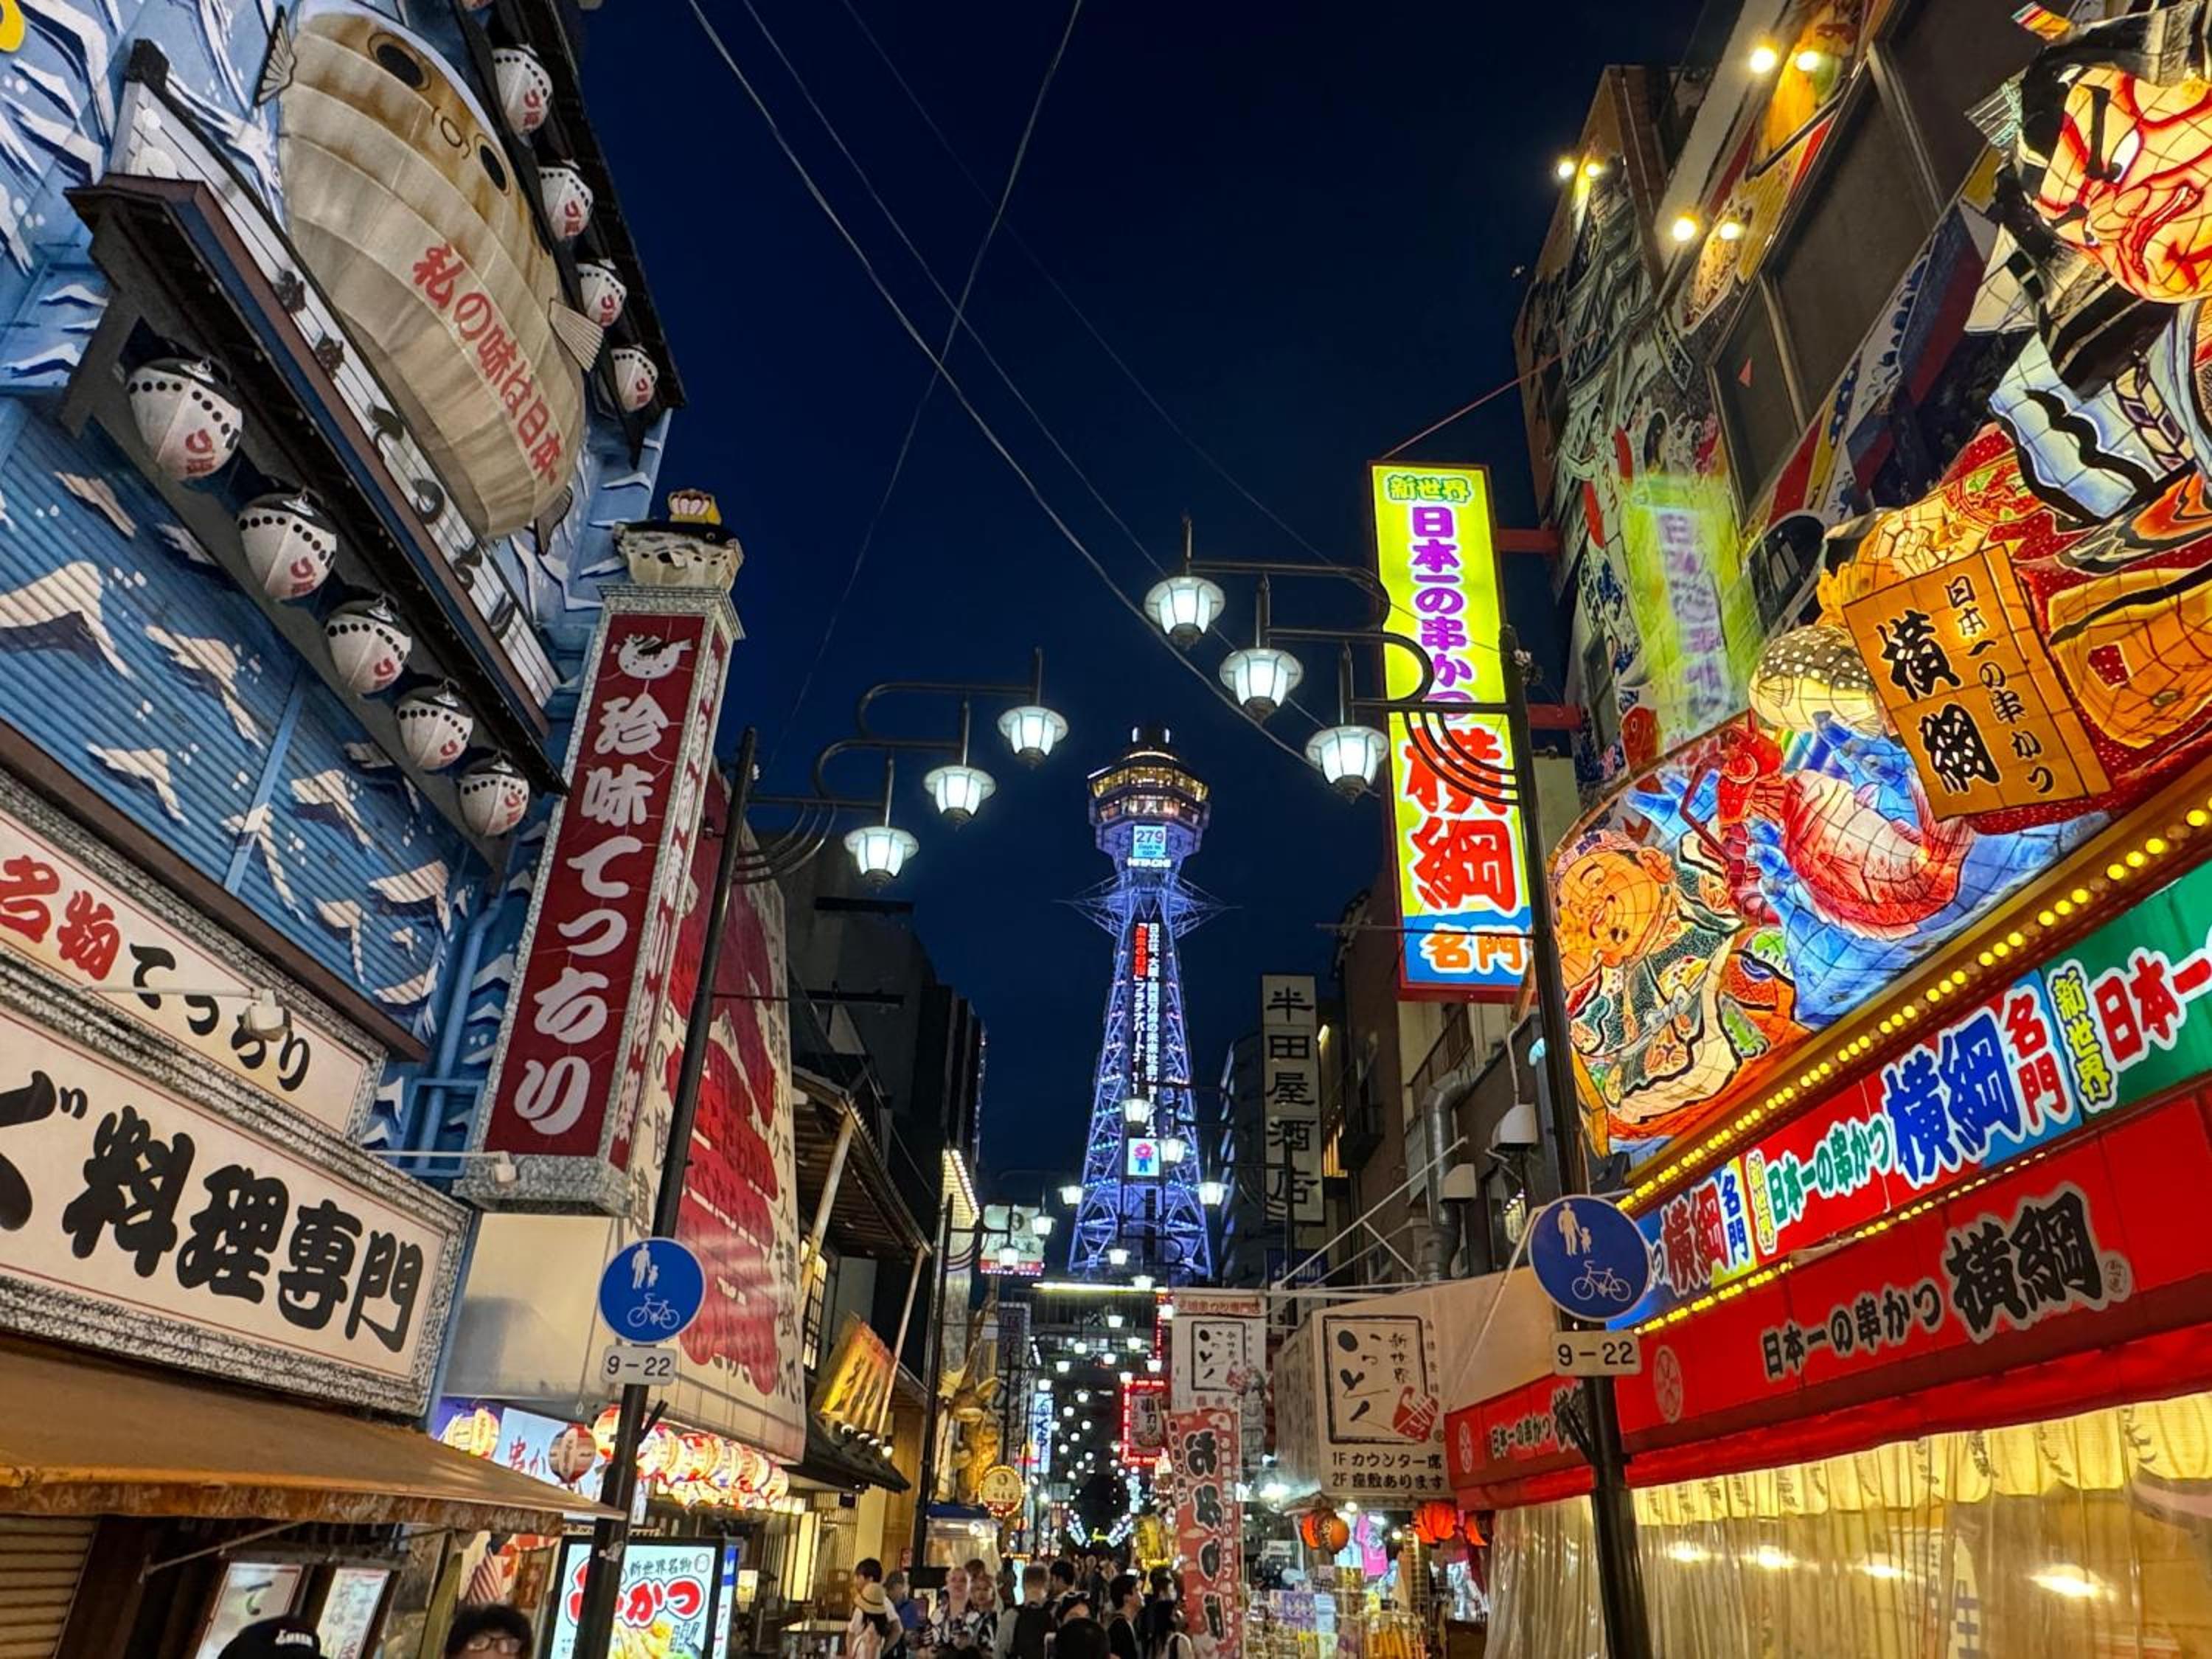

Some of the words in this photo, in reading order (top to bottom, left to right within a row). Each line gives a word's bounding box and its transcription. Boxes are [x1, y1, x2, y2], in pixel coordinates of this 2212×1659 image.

[1388, 476, 1471, 502] 新世界
[1877, 609, 2000, 795] 横綱
[1946, 576, 2054, 793] 日本一の串かつ
[1136, 830, 1164, 844] 279
[1405, 728, 1515, 911] 横綱
[1422, 928, 1525, 970] 名門
[1266, 987, 1317, 1205] 半田屋酒店
[2052, 966, 2112, 1104] 新世界
[1767, 1119, 1890, 1225] 日本一の串かつ
[1885, 1014, 2022, 1181] 横綱
[2006, 994, 2067, 1127] 名門
[1663, 1187, 1725, 1294] 横綱
[1721, 1174, 1747, 1260] 名門
[1763, 1285, 1941, 1376] 日本一の串かつ
[1947, 1192, 2101, 1332] 横綱
[1333, 1453, 1346, 1467] 1F
[1333, 1474, 1347, 1487] 2F
[1353, 1474, 1443, 1488] 座敷あります
